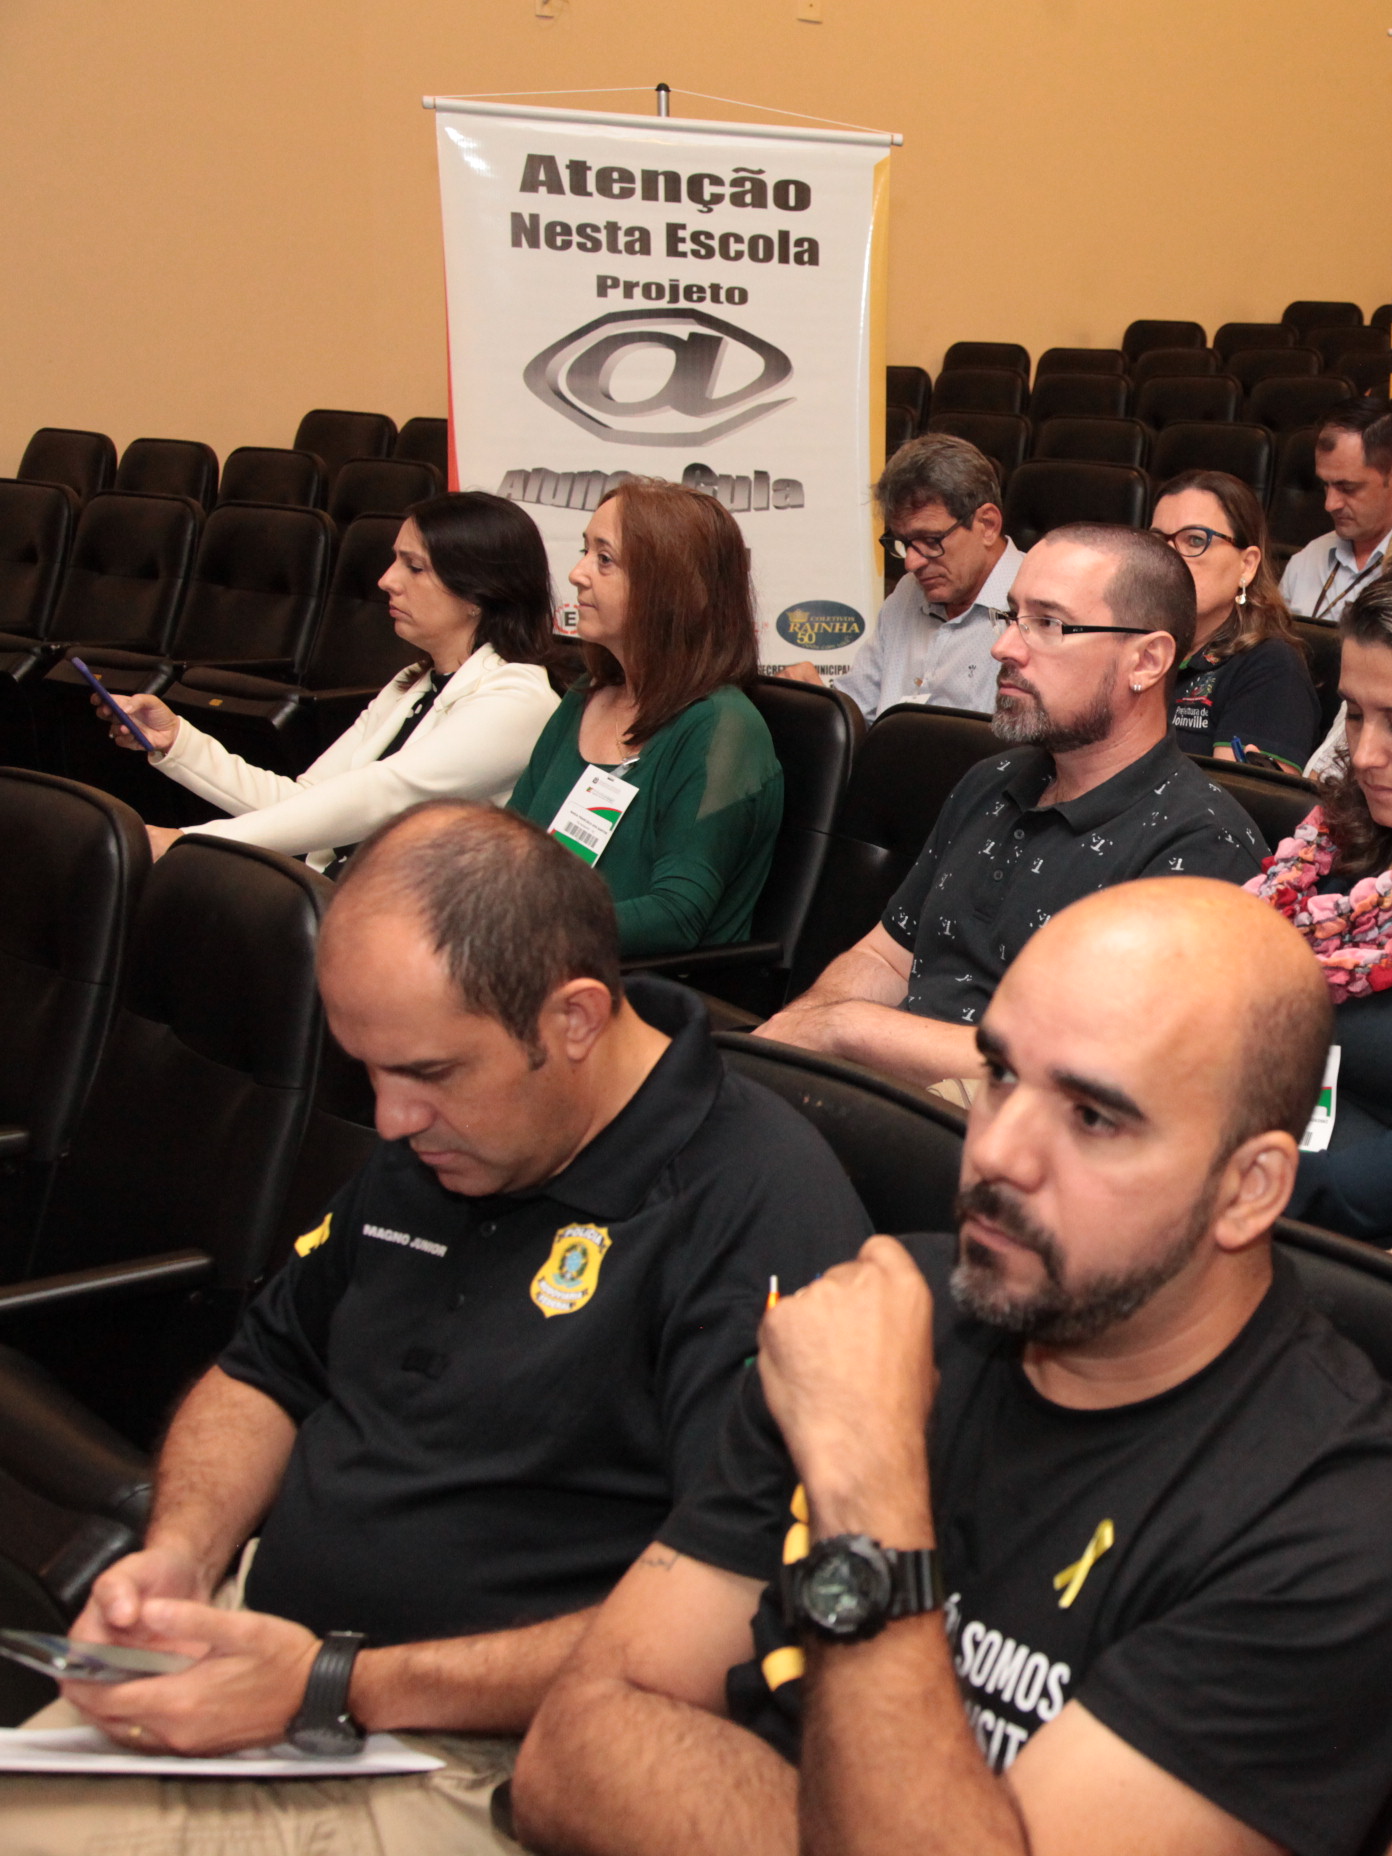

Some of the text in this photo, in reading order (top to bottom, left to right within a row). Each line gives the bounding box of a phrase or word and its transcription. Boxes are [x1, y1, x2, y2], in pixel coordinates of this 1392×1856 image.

[519, 153, 812, 214] Atenção
[511, 211, 820, 266] Nesta Escola
[596, 274, 748, 305] Projeto
[789, 622, 860, 633] RAINHA
[797, 631, 816, 645] 50
[362, 1223, 411, 1246] MAGNO
[955, 1620, 1071, 1722] SOMOS
